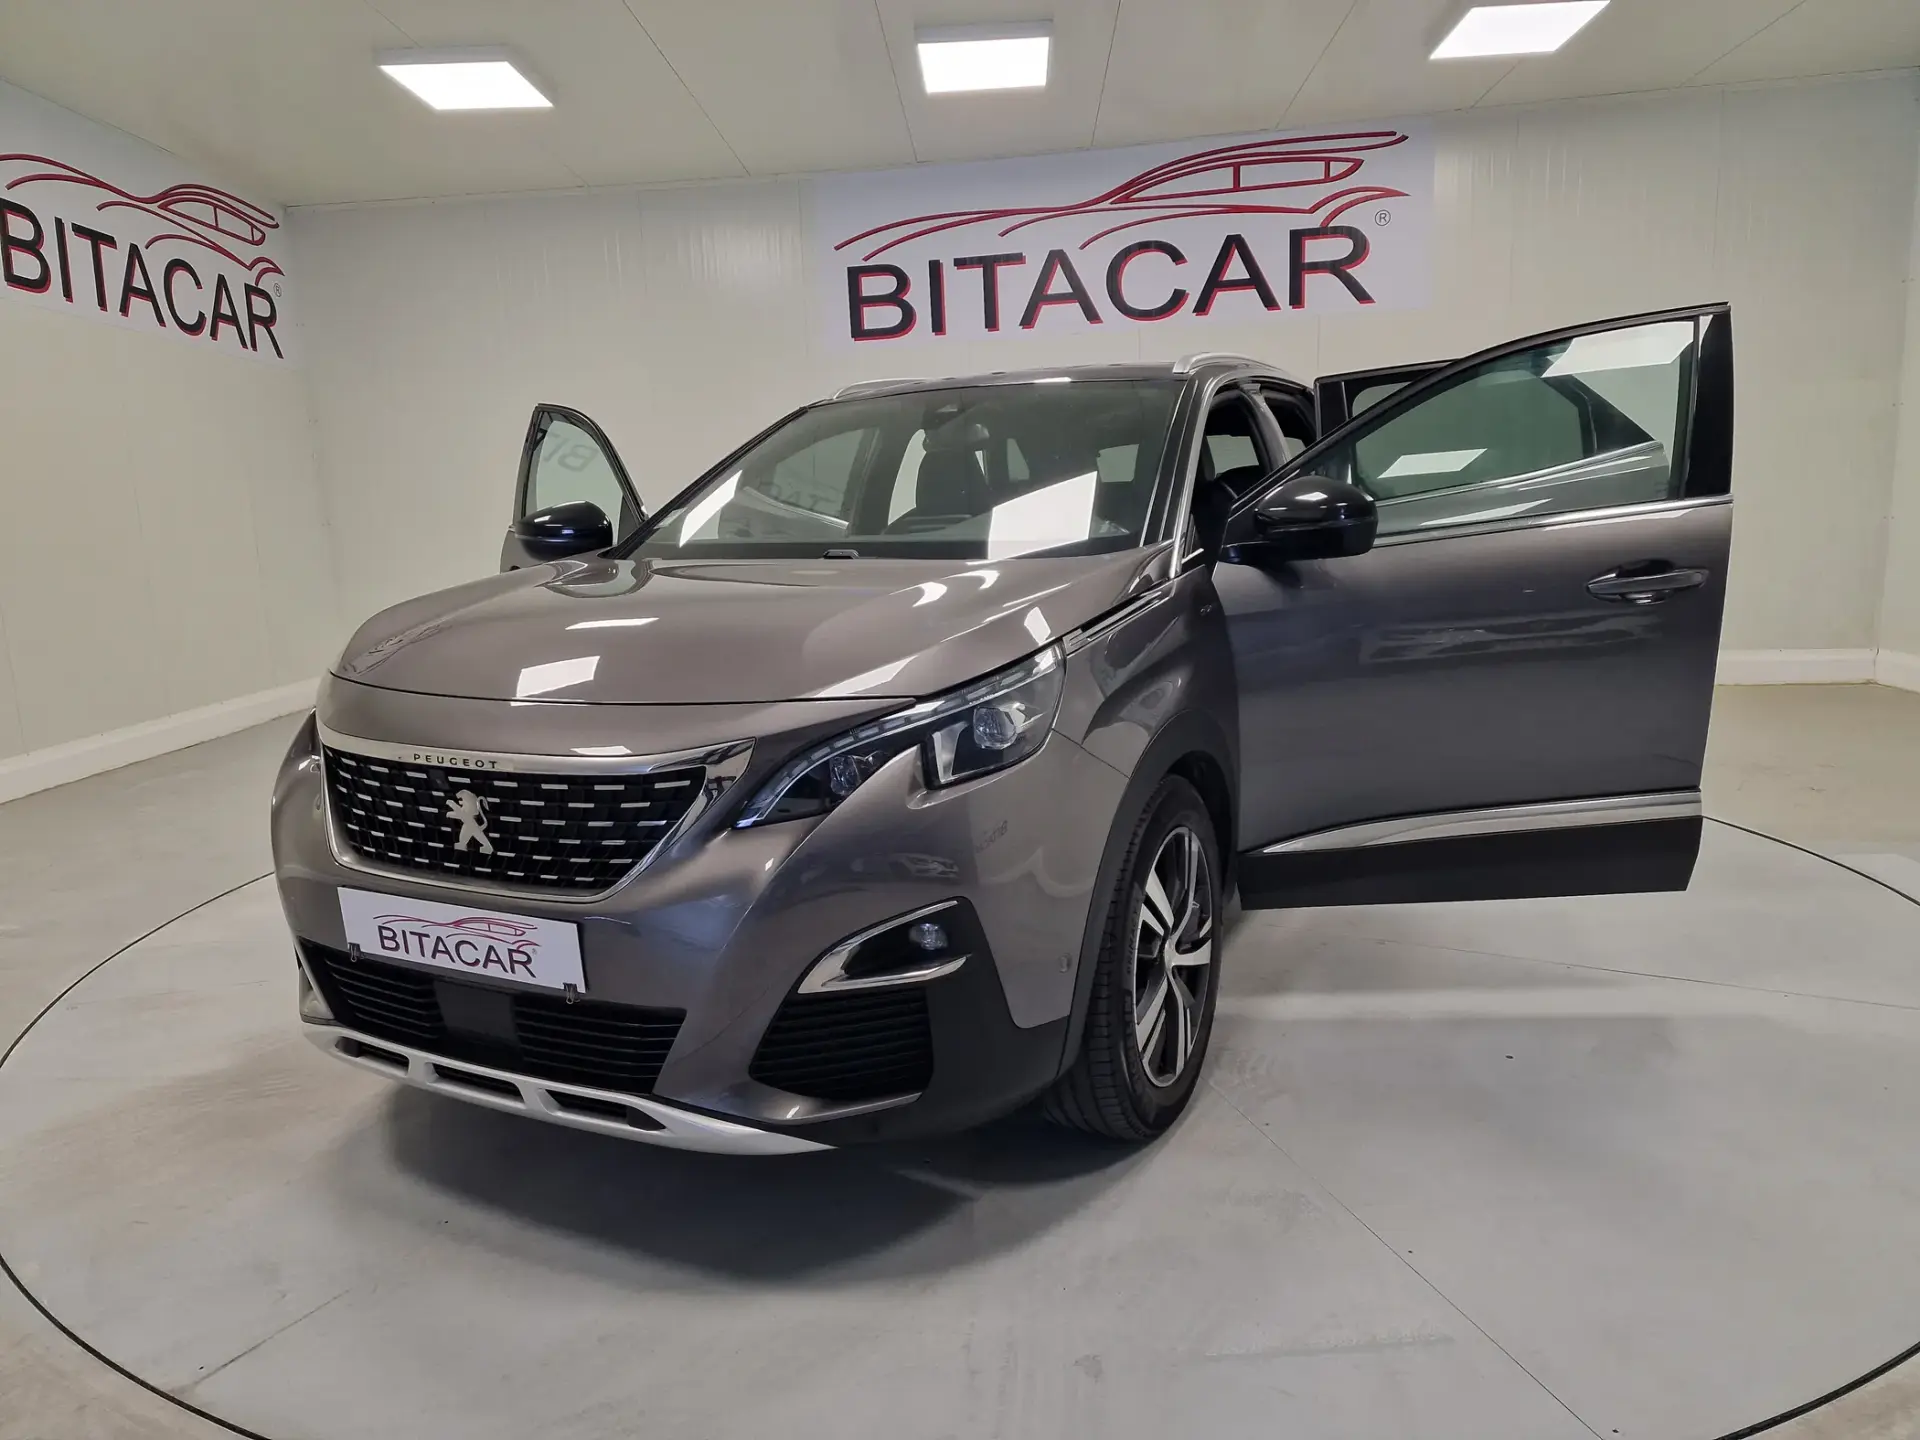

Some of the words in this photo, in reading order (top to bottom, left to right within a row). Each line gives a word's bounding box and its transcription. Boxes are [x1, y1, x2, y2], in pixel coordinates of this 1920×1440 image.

[0, 198, 284, 359] BITACAR
[847, 225, 1376, 342] BITACAR
[413, 753, 498, 769] PEUGEOT
[377, 925, 537, 979] BITACAR
